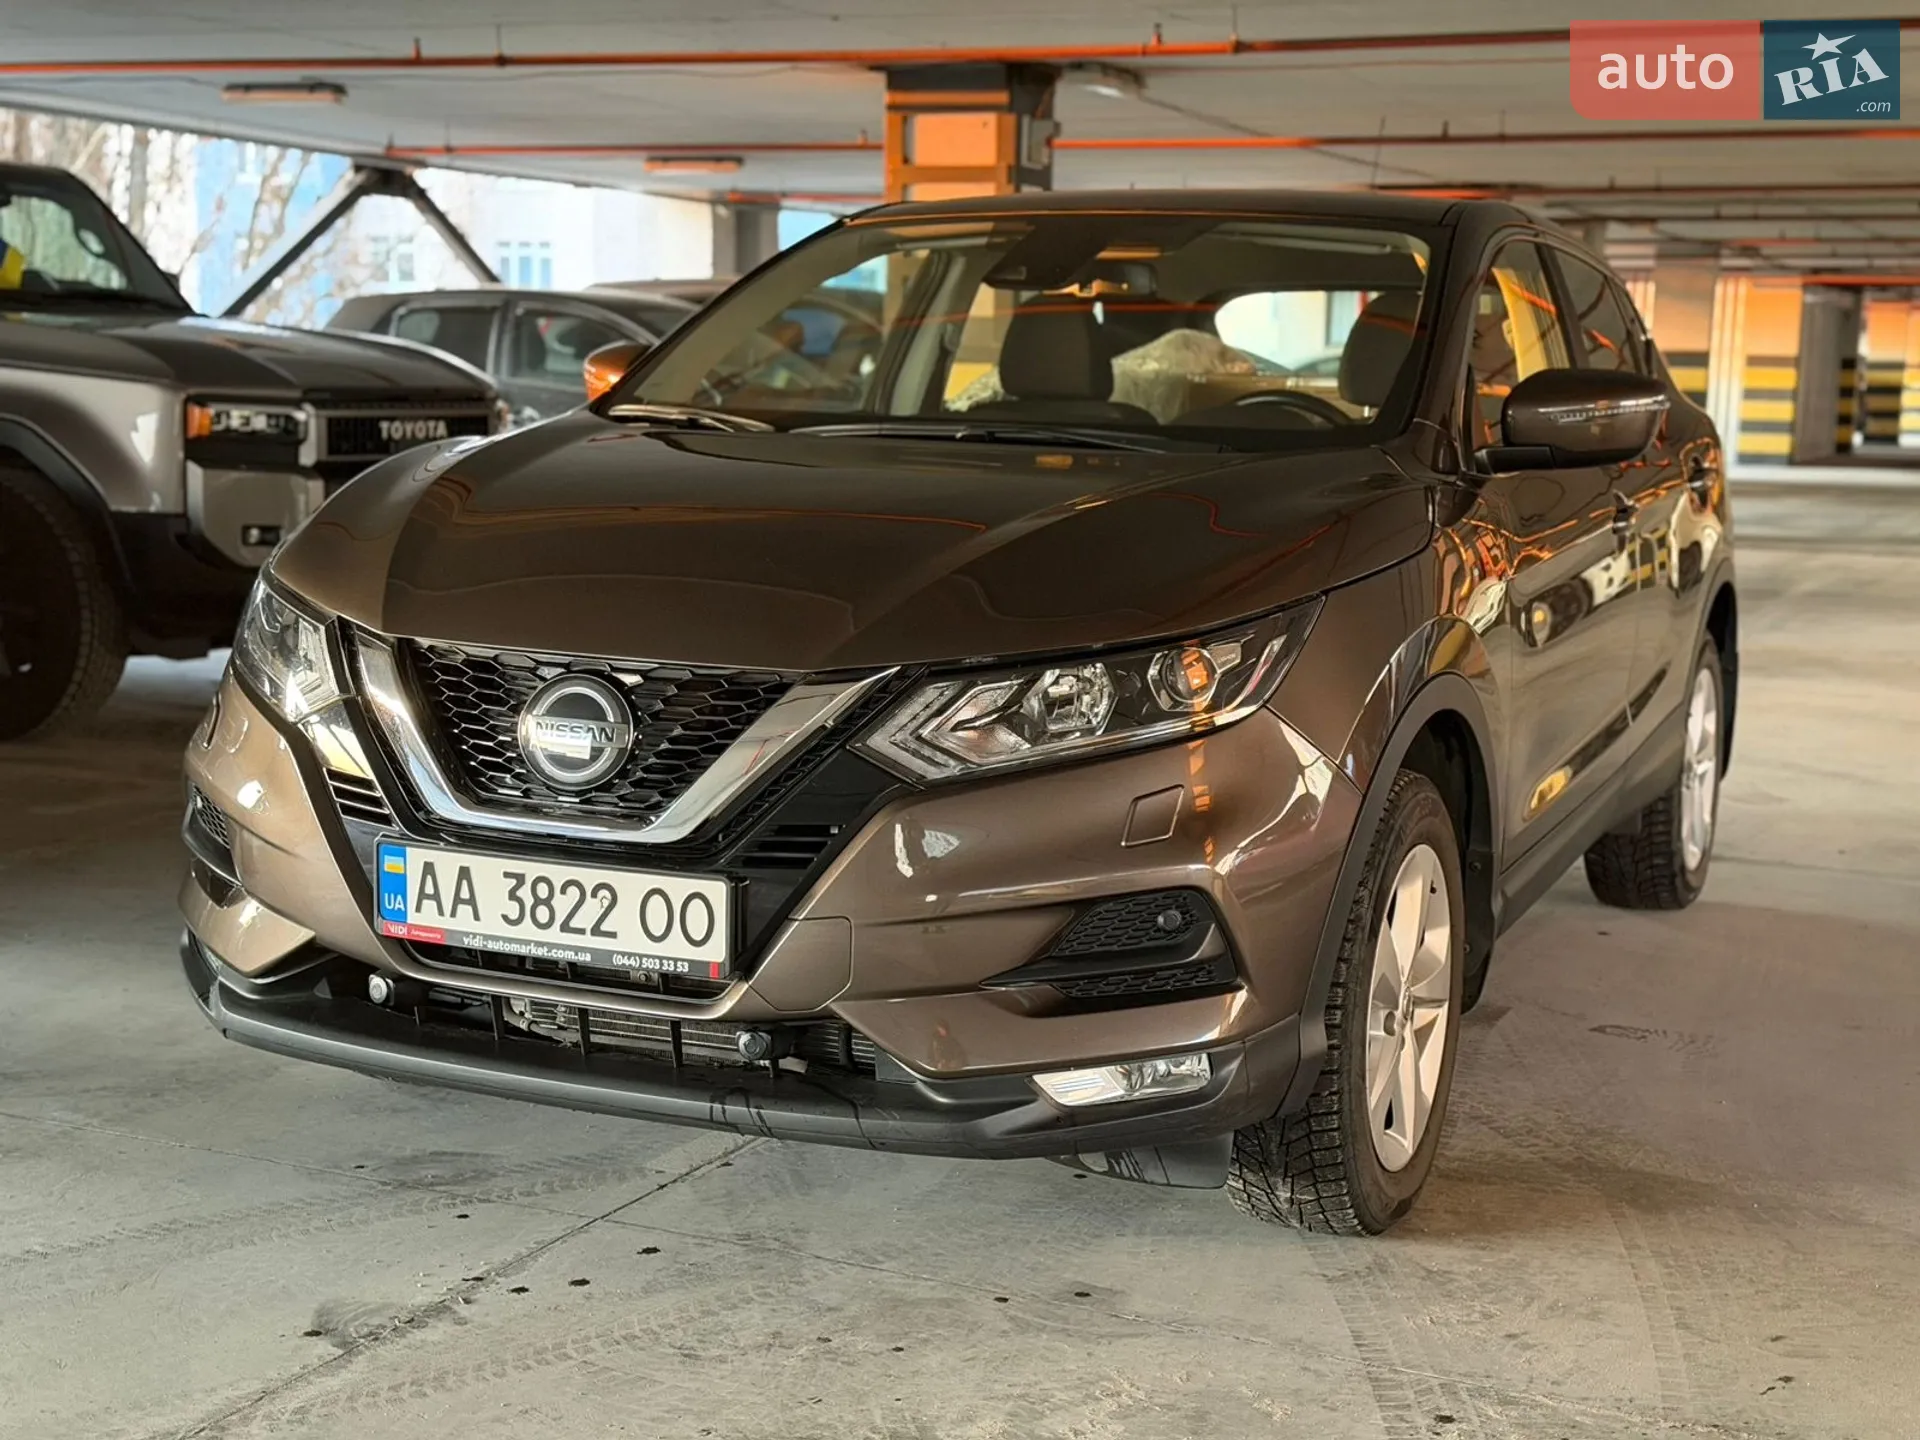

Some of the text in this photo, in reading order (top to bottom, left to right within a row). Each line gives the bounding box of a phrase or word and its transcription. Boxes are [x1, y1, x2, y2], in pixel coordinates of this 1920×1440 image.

[378, 420, 448, 440] TOYOTA
[535, 720, 617, 744] NISSAN
[385, 893, 406, 912] UA
[415, 860, 480, 922] AA
[500, 871, 618, 939] 3822
[387, 922, 408, 936] VIDI
[462, 934, 591, 962] vidi-automarket.com.ua
[612, 953, 689, 972] (044) 503 33 53
